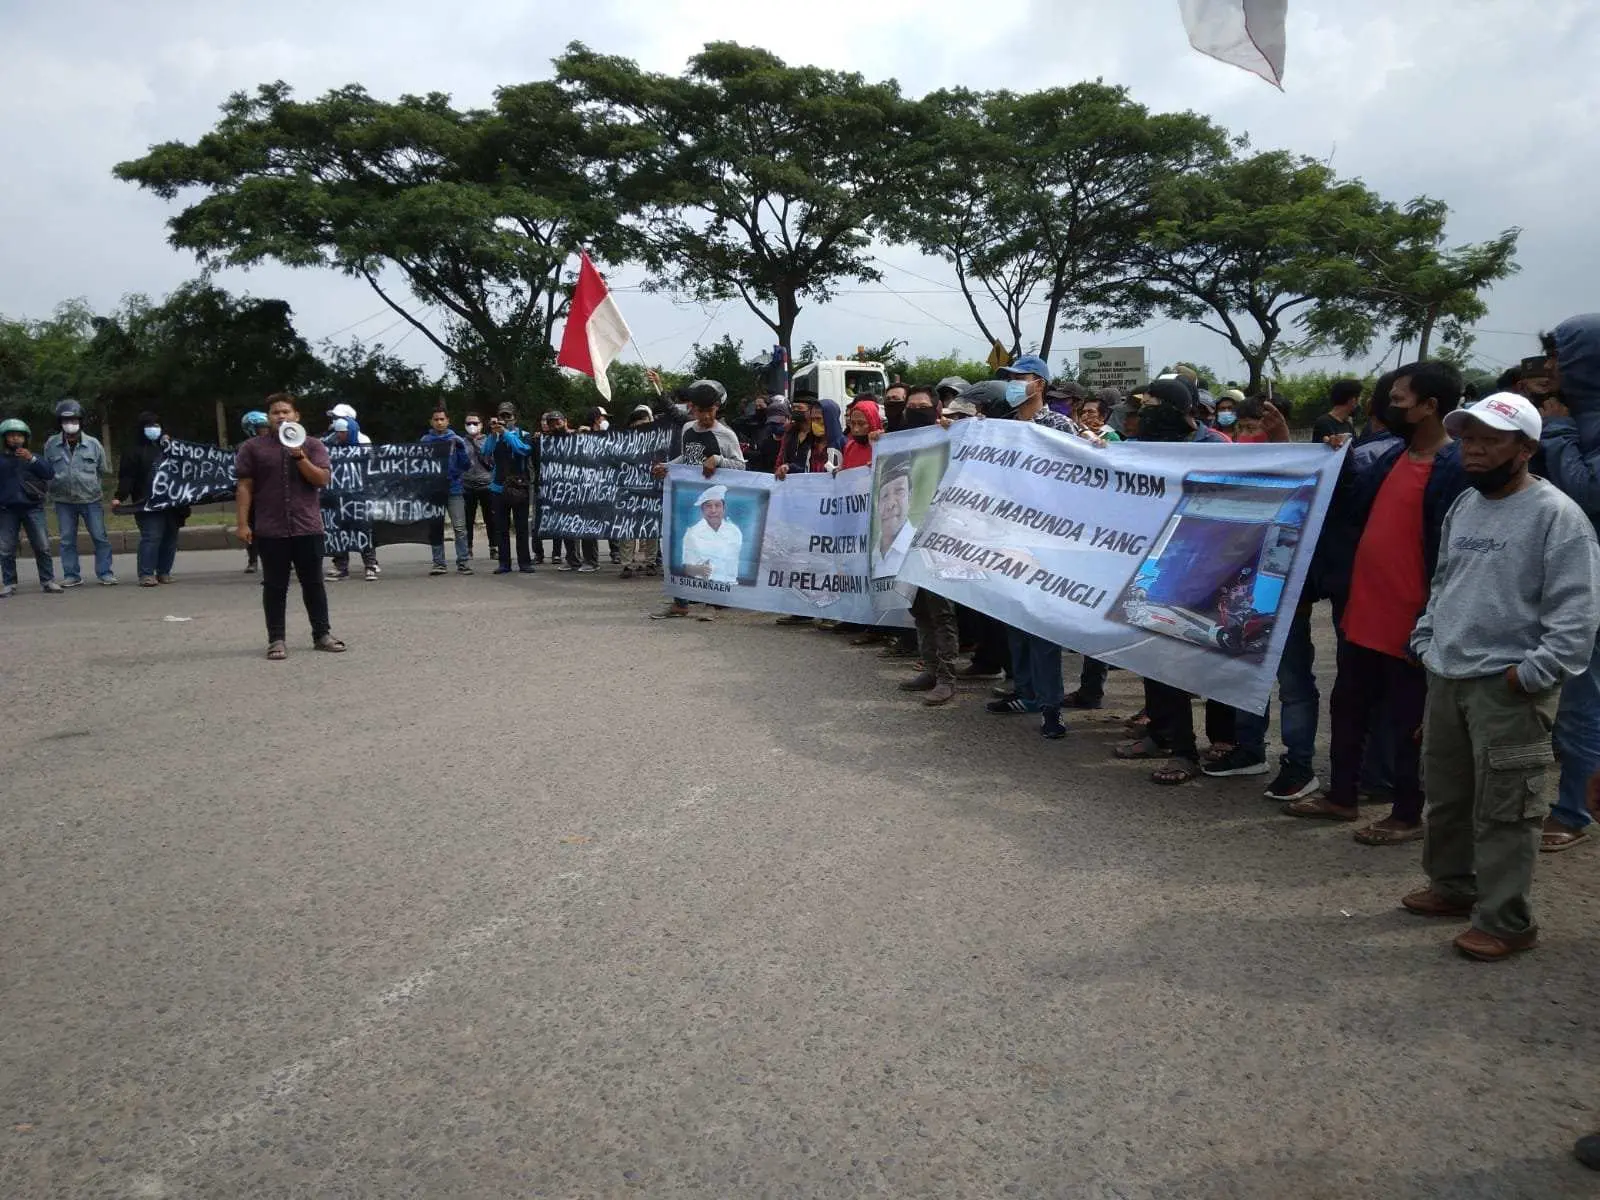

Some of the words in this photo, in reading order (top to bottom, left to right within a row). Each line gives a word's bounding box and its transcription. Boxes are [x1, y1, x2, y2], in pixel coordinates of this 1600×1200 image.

[326, 445, 371, 460] AKYAT
[540, 433, 573, 457] KAMI
[1022, 454, 1109, 491] KOPERASI
[1114, 470, 1166, 499] TKBM
[611, 514, 637, 538] HAK
[993, 500, 1085, 542] MARUNDA
[1088, 525, 1148, 556] YANG
[768, 570, 784, 588] DI
[789, 571, 863, 594] PELABUHAN
[928, 531, 1027, 580] BERMUATAN
[1026, 567, 1108, 610] PUNGLI
